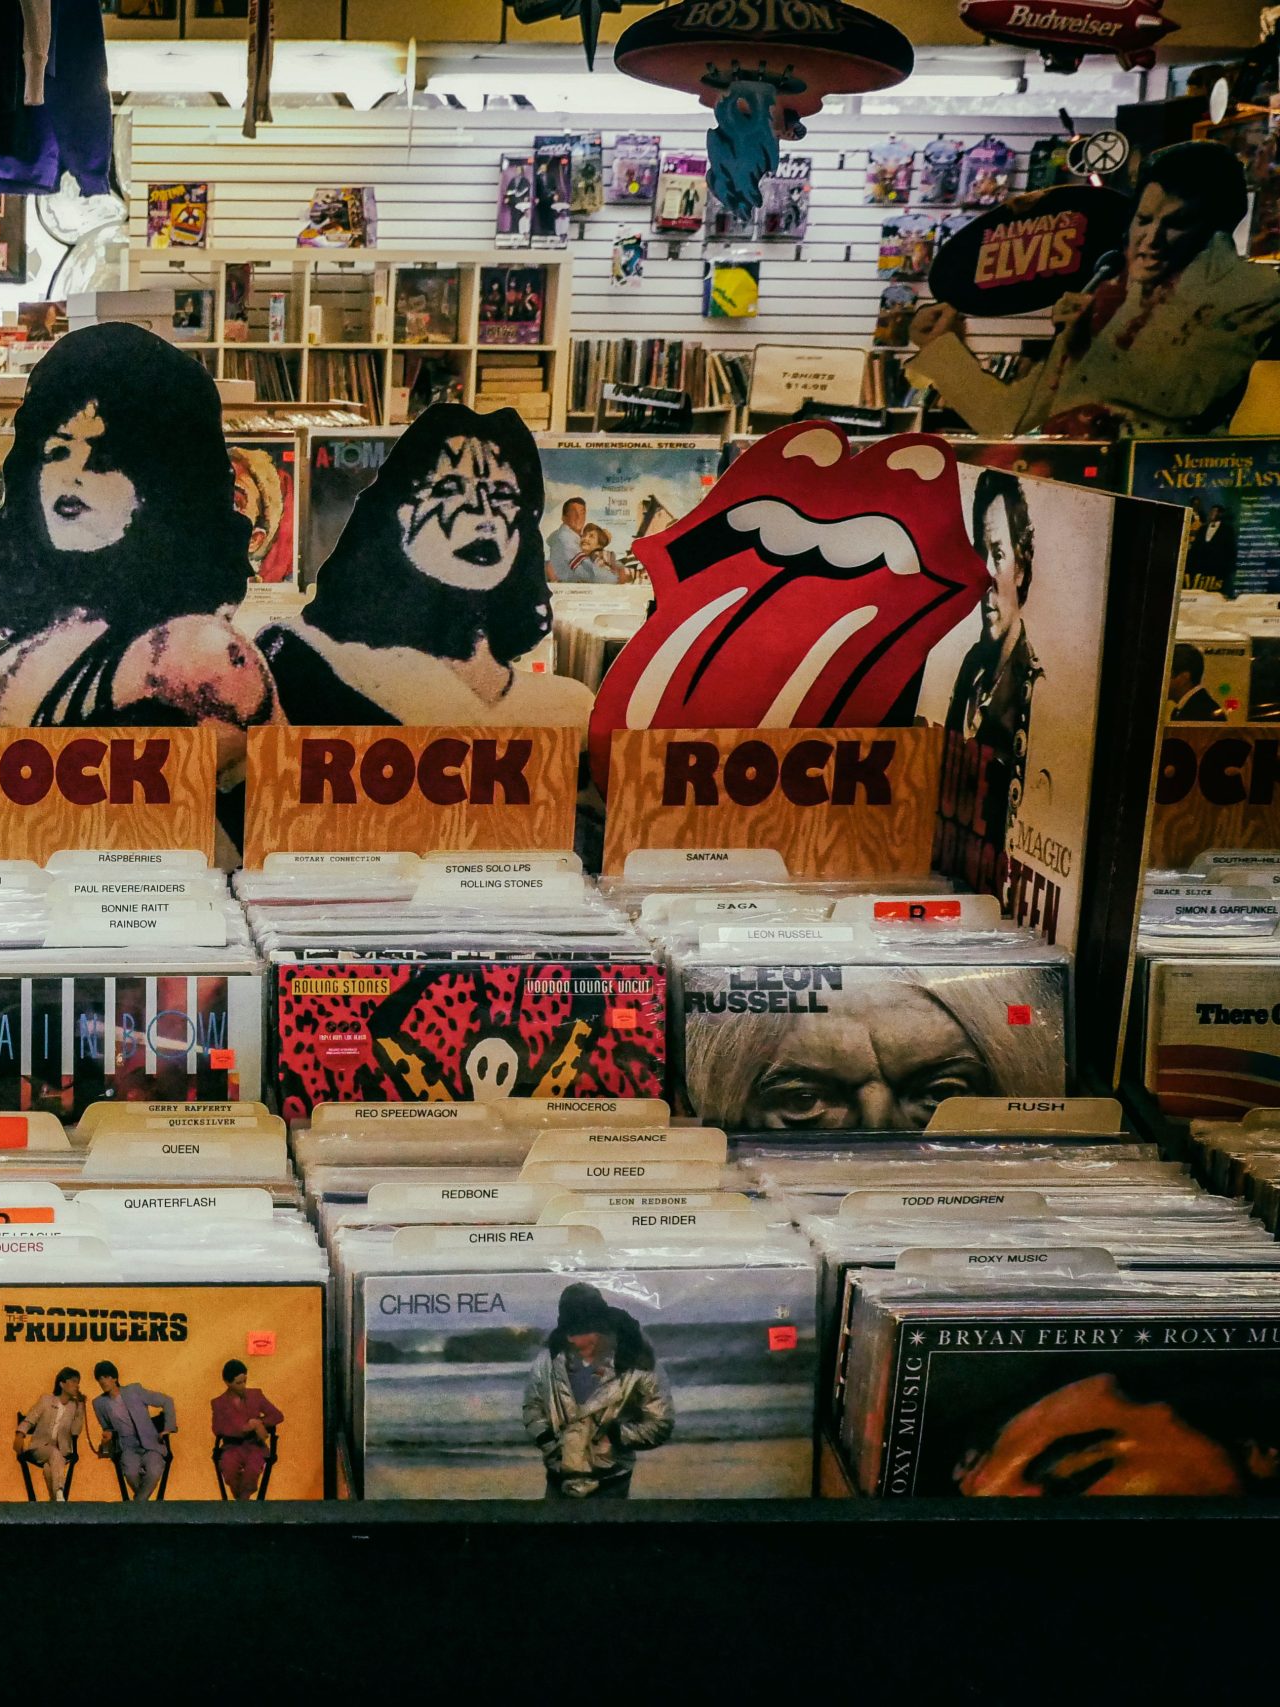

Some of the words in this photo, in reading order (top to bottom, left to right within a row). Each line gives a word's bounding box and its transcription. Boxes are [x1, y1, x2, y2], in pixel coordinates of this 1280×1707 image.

[682, 0, 835, 31] BOSTON
[1007, 5, 1123, 37] Budweiser
[991, 212, 1072, 241] ALWAYS
[975, 229, 1078, 287] ELVIS
[1174, 453, 1253, 468] Memories
[299, 739, 533, 805] ROCK
[662, 740, 894, 806] ROCK
[1155, 738, 1280, 805] OCK
[1014, 821, 1072, 878] MAGIC
[98, 855, 162, 863] RASPBERRIES
[686, 853, 729, 861] SANTANA
[445, 864, 483, 873] STONES
[486, 864, 511, 873] SOLO
[514, 864, 531, 872] LPS
[74, 885, 99, 893] PAUL
[102, 884, 185, 893] REVERE/RAIDERS
[460, 880, 502, 889] ROLLING
[504, 880, 543, 888] STONES
[101, 904, 138, 912] BONNIE
[141, 904, 169, 912] RAITT
[1176, 906, 1207, 914] SIMON
[1210, 906, 1216, 914] &
[1220, 905, 1278, 914] GARFUNKEL
[109, 920, 157, 929] RAINBOW
[747, 930, 775, 939] LEON
[777, 930, 823, 939] RUSSELL
[730, 966, 843, 991] LEON
[293, 980, 339, 994] ROLLING
[343, 980, 389, 994] STONES
[527, 979, 569, 994] VOODOO
[575, 979, 614, 994] LOUNGE
[618, 979, 651, 994] UNCUT
[685, 992, 829, 1014] RUSSELL
[1196, 1003, 1269, 1026] There
[547, 1103, 616, 1112] RHINOCEROS
[1007, 1103, 1066, 1112] RUSH
[355, 1109, 377, 1118] REO
[381, 1109, 458, 1118] SPEEDWAGON
[169, 1118, 236, 1127] QUICKSILVER
[589, 1134, 667, 1143] RENAISSANCE
[162, 1144, 200, 1155] QUEEN
[586, 1167, 610, 1177] LOU
[613, 1167, 645, 1176] REED
[441, 1188, 499, 1200] REDBONE
[124, 1197, 216, 1209] QUARTERFLASH
[641, 1198, 687, 1206] REDBONE
[902, 1196, 934, 1206] TODD
[937, 1195, 1005, 1205] RUNDGREN
[631, 1215, 656, 1226] RED
[661, 1215, 697, 1226] RIDER
[469, 1232, 506, 1243] CHRIS
[509, 1231, 534, 1242] REA
[968, 1255, 1003, 1264] ROXY
[1007, 1254, 1048, 1263] MUSIC
[379, 1293, 451, 1316] CHRIS
[457, 1292, 506, 1314] REA
[4, 1304, 187, 1342] PRODUCERS
[7, 1314, 28, 1323] THE
[938, 1330, 1025, 1346] BRYAN
[1039, 1328, 1124, 1345] FERRY
[1164, 1328, 1237, 1343] ROXY
[898, 1357, 923, 1435] MUSIC
